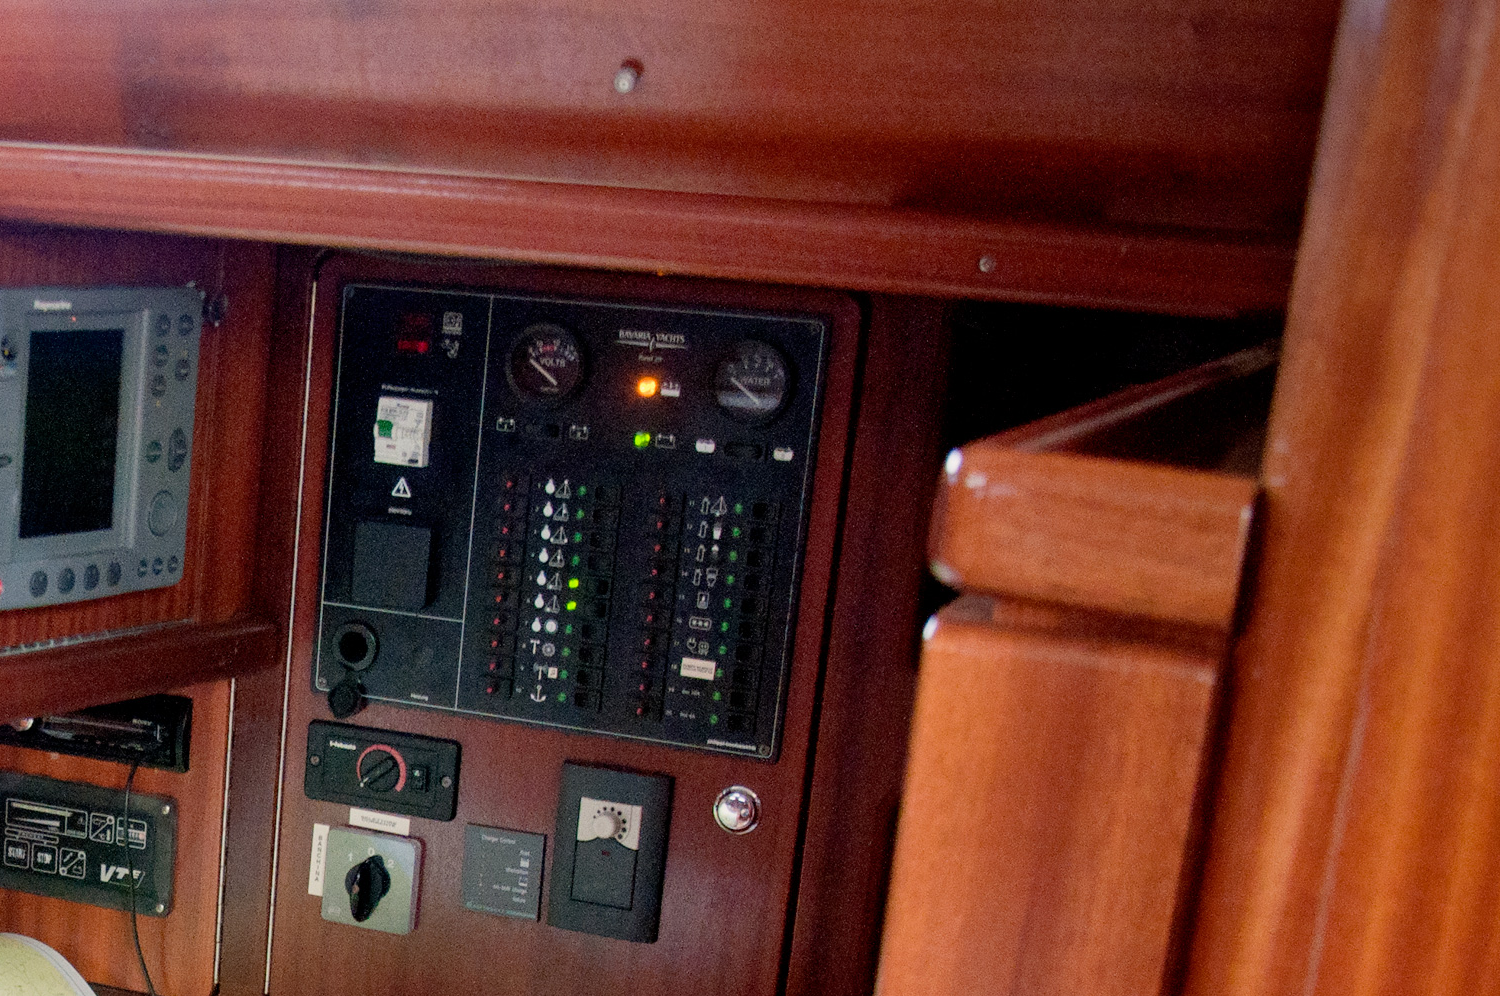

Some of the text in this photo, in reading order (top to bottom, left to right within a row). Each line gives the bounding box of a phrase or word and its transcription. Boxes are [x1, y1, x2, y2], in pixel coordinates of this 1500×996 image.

[619, 329, 685, 344] BAVARIA YACHTS
[36, 852, 52, 864] STOP
[314, 835, 323, 882] BANCHINA
